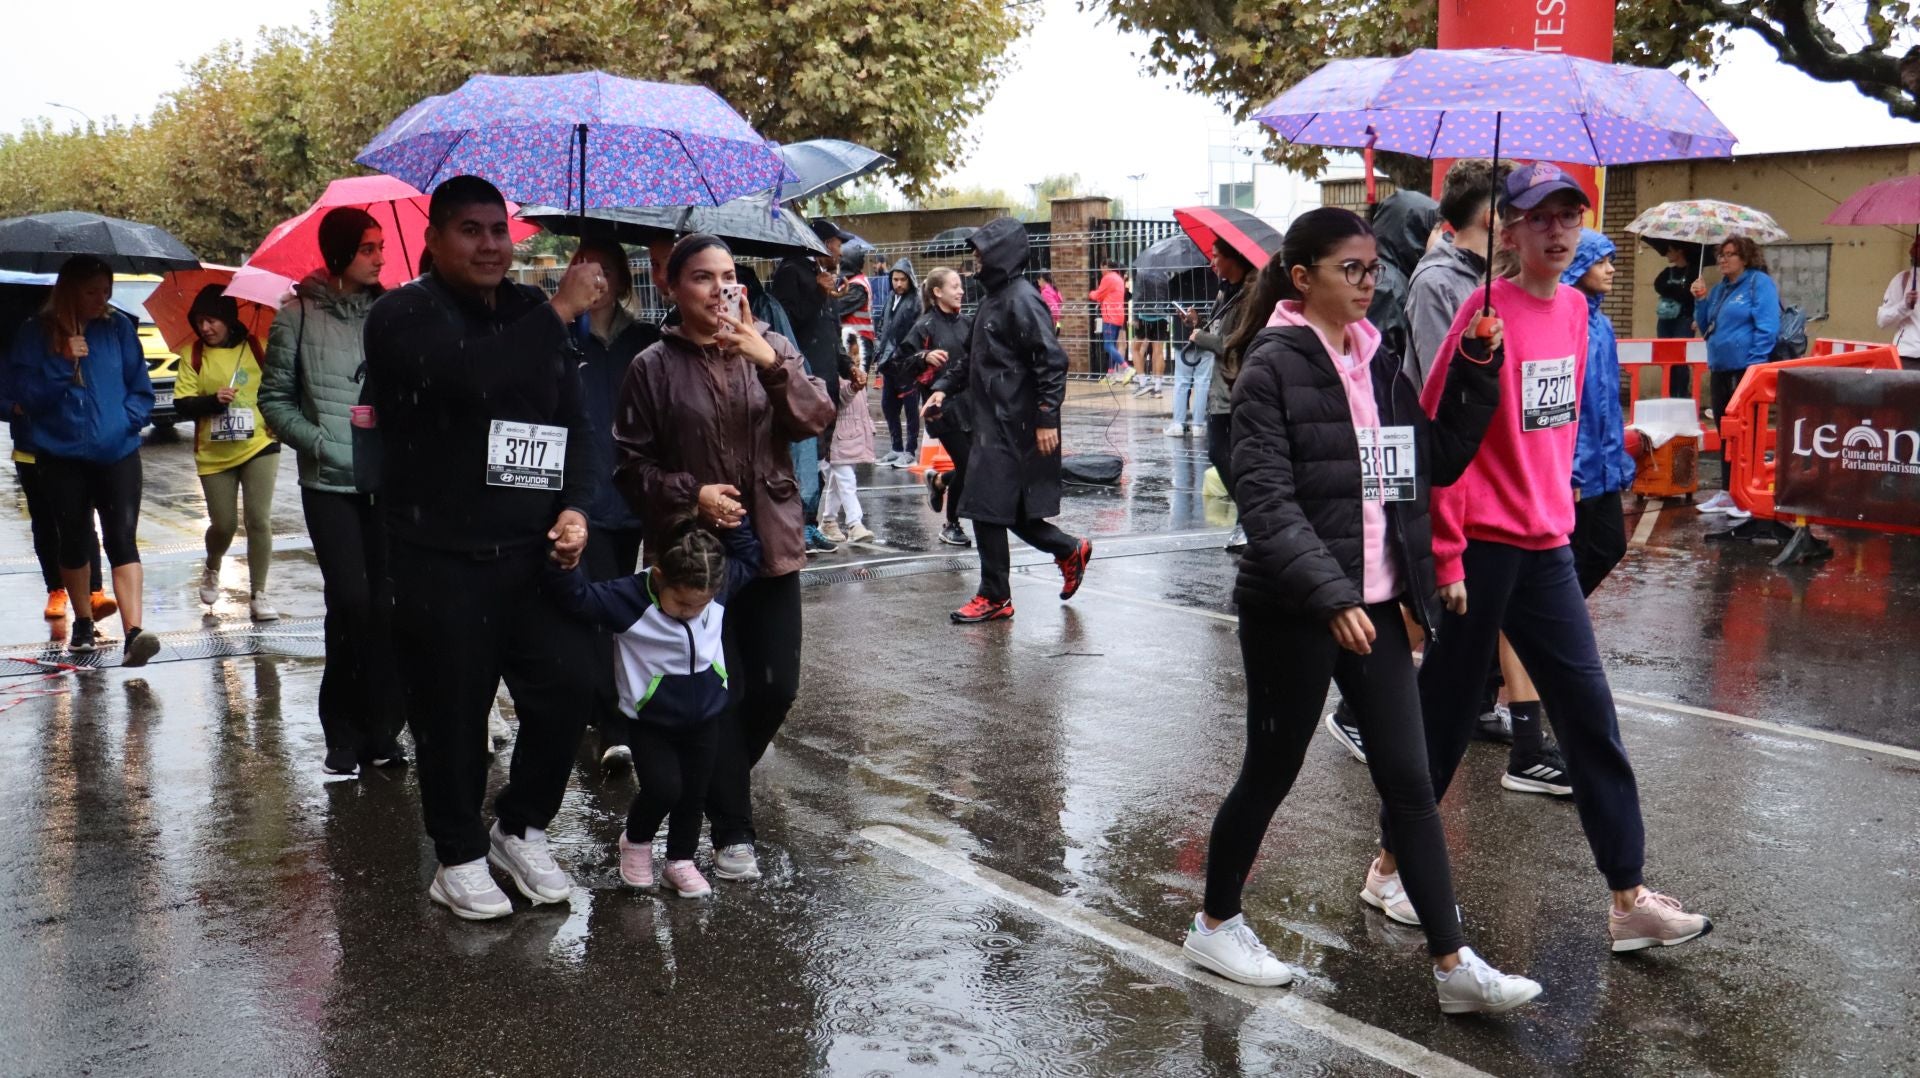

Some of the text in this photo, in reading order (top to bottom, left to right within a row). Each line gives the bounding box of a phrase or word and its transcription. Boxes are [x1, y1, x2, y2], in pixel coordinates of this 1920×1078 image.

[1537, 374, 1572, 406] 2377
[505, 438, 548, 467] 3717
[1841, 448, 1883, 461] Cuna del
[515, 474, 549, 485] HYUNDAI
[1363, 487, 1399, 497] HYUDAI
